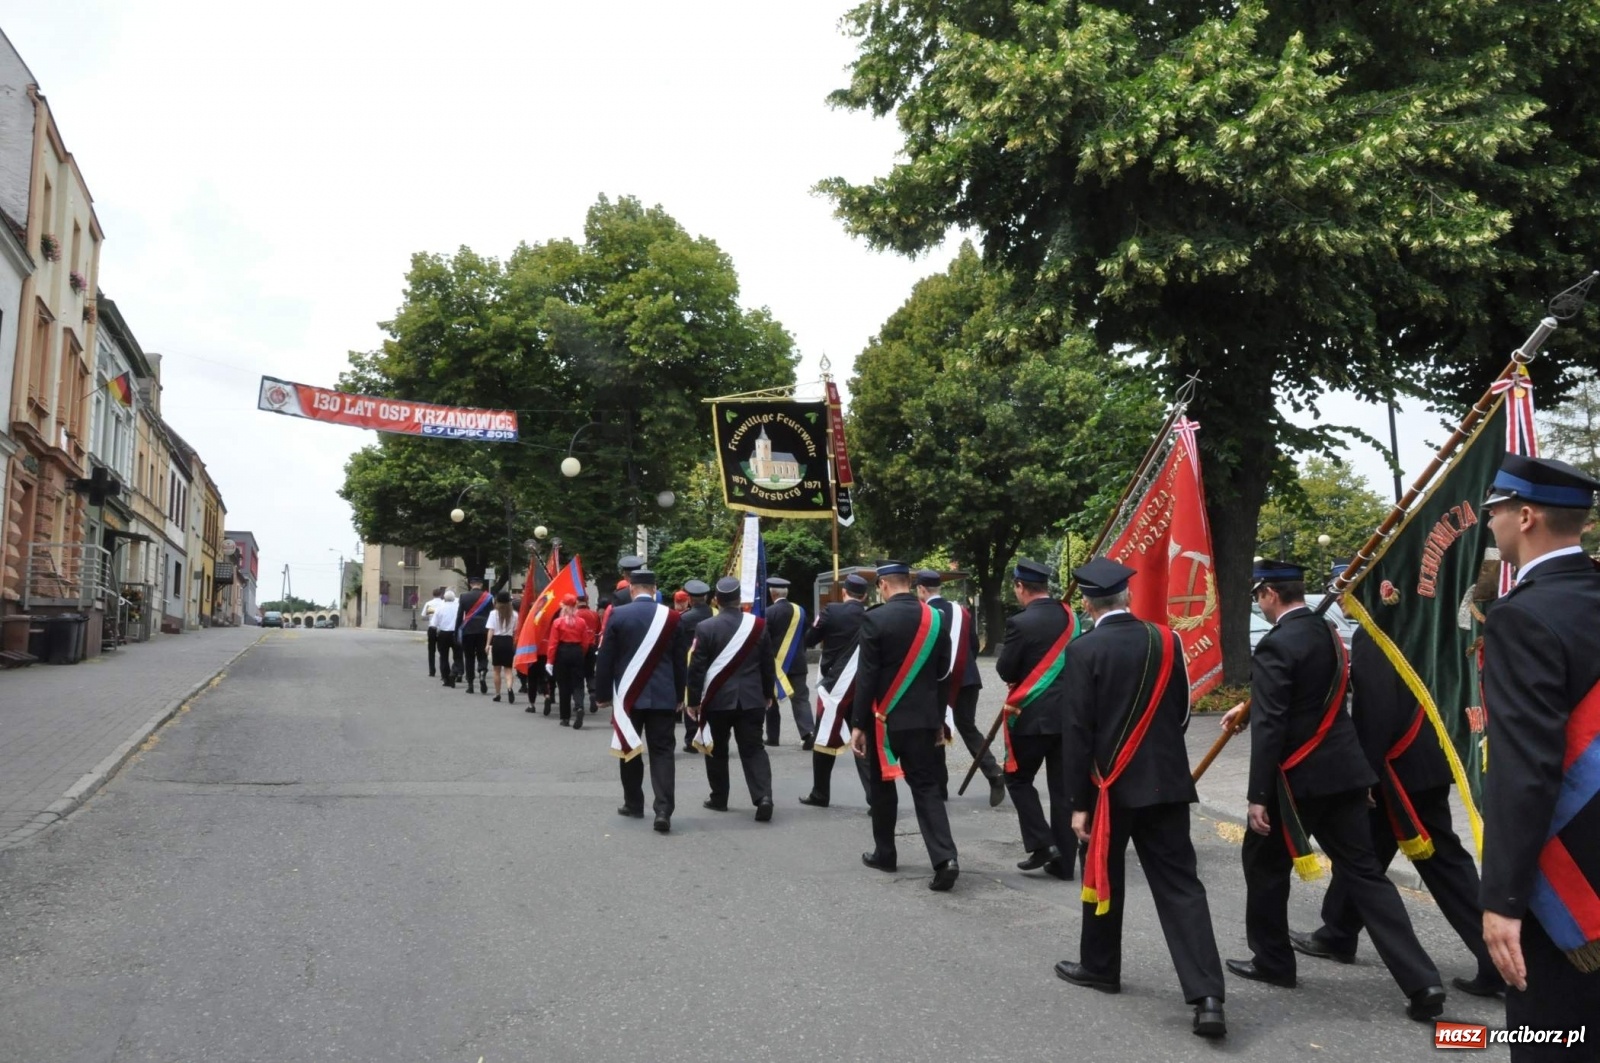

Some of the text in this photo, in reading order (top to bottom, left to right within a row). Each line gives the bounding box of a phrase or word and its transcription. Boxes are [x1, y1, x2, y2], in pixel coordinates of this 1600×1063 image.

[313, 392, 515, 431] 130 LAT OSP KRZANOWICE
[423, 425, 515, 439] 6-7 LIPIEC 2019
[776, 412, 817, 458] Feuerwehr
[803, 480, 822, 490] 1971
[1417, 500, 1478, 598] OCHOTNICZA
